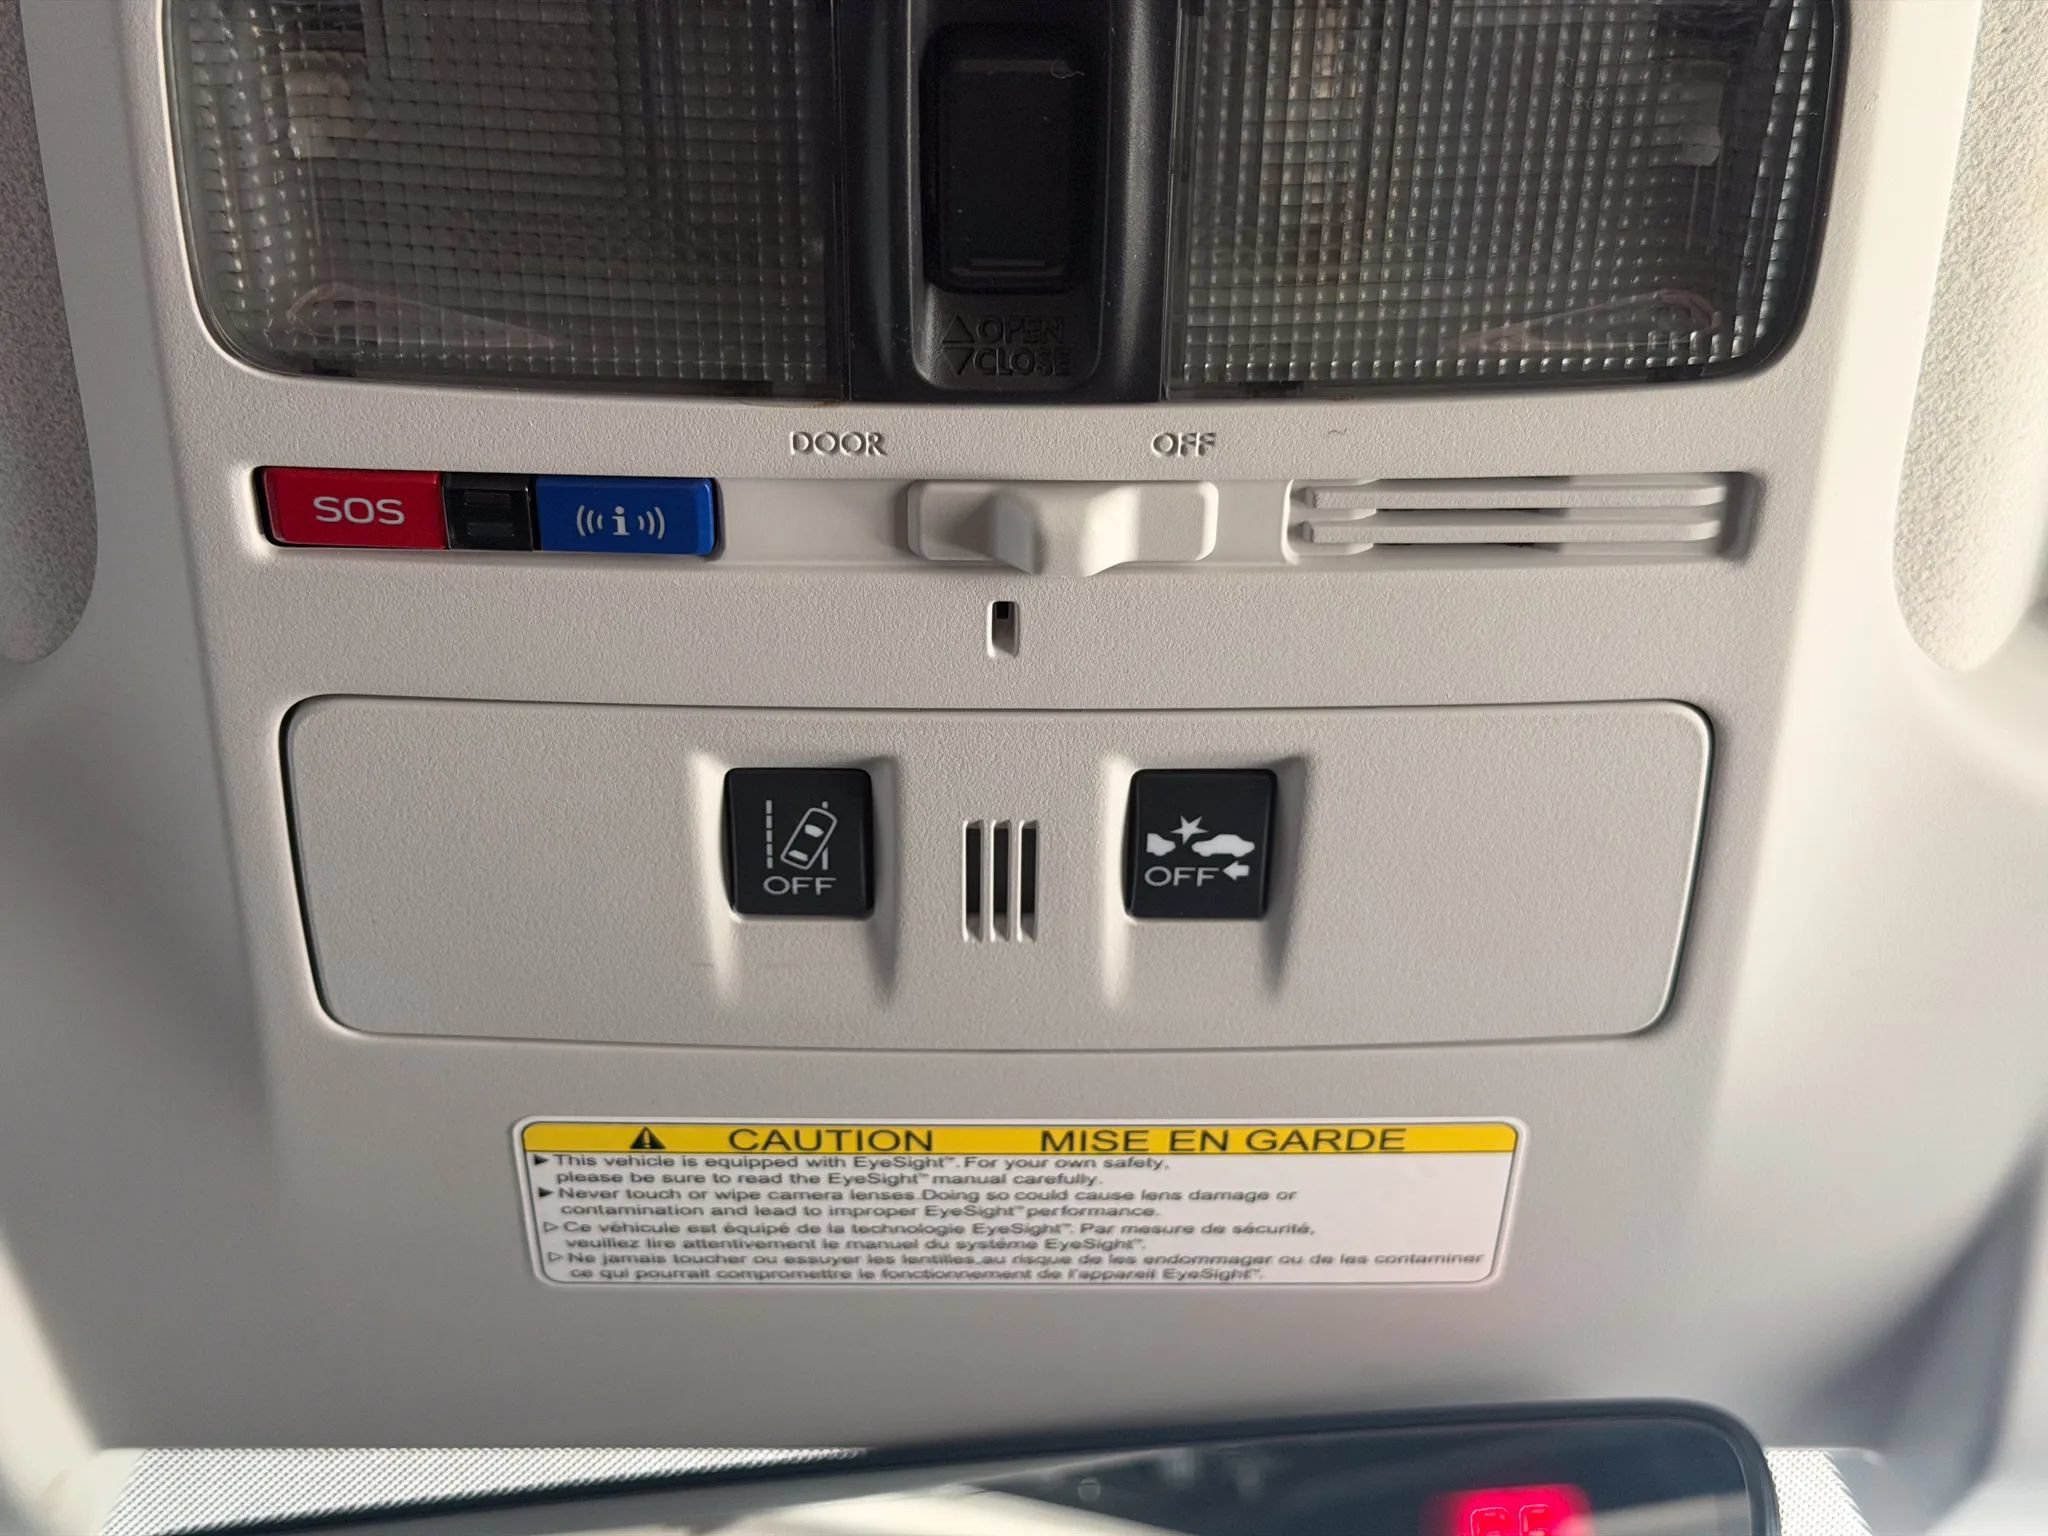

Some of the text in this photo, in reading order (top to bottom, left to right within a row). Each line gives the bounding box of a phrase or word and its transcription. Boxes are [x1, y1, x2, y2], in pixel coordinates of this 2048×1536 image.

[977, 315, 1064, 345] OPEN
[973, 347, 1071, 376] CLOSE
[789, 431, 887, 457] DOOR
[1150, 431, 1216, 457] OFF
[313, 496, 405, 525] SOS
[763, 876, 837, 895] OFF
[1144, 866, 1219, 887] OFF
[729, 1129, 933, 1152] CAUTION
[1041, 1128, 1407, 1152] MISE EN GARDE
[554, 1154, 597, 1166] This
[604, 1155, 675, 1167] vehicle
[682, 1155, 697, 1167] is
[705, 1156, 798, 1169] equipped
[807, 1157, 845, 1167] with
[964, 1157, 997, 1168] For
[1005, 1158, 1048, 1170] your
[1054, 1158, 1096, 1168] own
[1103, 1157, 1169, 1170] safety,
[557, 1172, 622, 1185] please
[630, 1173, 654, 1183] be
[663, 1174, 705, 1183] sure
[713, 1174, 731, 1183] to
[738, 1173, 782, 1184] read
[790, 1173, 820, 1184] the
[933, 1174, 1006, 1184] manual
[1013, 1174, 1102, 1186] carefully.
[558, 1188, 619, 1199] Never
[626, 1189, 681, 1199] touch
[689, 1190, 708, 1199] or
[715, 1189, 761, 1202] wipe
[768, 1190, 843, 1200] camera
[922, 1190, 979, 1202] Doing
[986, 1191, 1009, 1200] so
[1014, 1190, 1068, 1200] could
[1075, 1191, 1134, 1200] cause
[1141, 1190, 1181, 1200] lens
[1188, 1190, 1269, 1203] damage
[1277, 1191, 1296, 1200] or
[561, 1204, 703, 1216] contamination
[711, 1205, 747, 1216] and
[754, 1205, 796, 1216] lead
[804, 1206, 821, 1216] to
[829, 1206, 917, 1218] improper
[1026, 1206, 1160, 1218] performance.
[564, 1222, 592, 1232] Ce
[599, 1221, 680, 1233] véhicule
[688, 1223, 716, 1233] est
[724, 1222, 789, 1235] équipé
[797, 1223, 821, 1234] de
[829, 1223, 844, 1234] la
[851, 1223, 964, 1236] technologie
[1080, 1223, 1112, 1234] Par
[1121, 1225, 1194, 1234] mesure
[1202, 1224, 1225, 1234] de
[566, 1238, 638, 1249] veuillez
[647, 1238, 675, 1249] lire
[683, 1238, 816, 1249] attentivement
[823, 1239, 839, 1249] le
[846, 1239, 918, 1249] manuel
[925, 1239, 949, 1249] du
[956, 1238, 1038, 1252] système
[568, 1253, 596, 1264] Ne
[602, 1253, 666, 1266] jamais
[673, 1254, 746, 1264] toucher
[754, 1255, 777, 1264] ou
[784, 1256, 860, 1267] essuyer
[868, 1254, 895, 1264] les
[1012, 1255, 1072, 1267] risque
[1078, 1254, 1103, 1265] de
[1109, 1254, 1136, 1265] les
[1279, 1255, 1301, 1265] ou
[1309, 1254, 1333, 1265] de
[1340, 1254, 1368, 1265] les
[600, 1268, 630, 1281] qui
[859, 1269, 875, 1280] le
[1037, 1269, 1061, 1280] de
